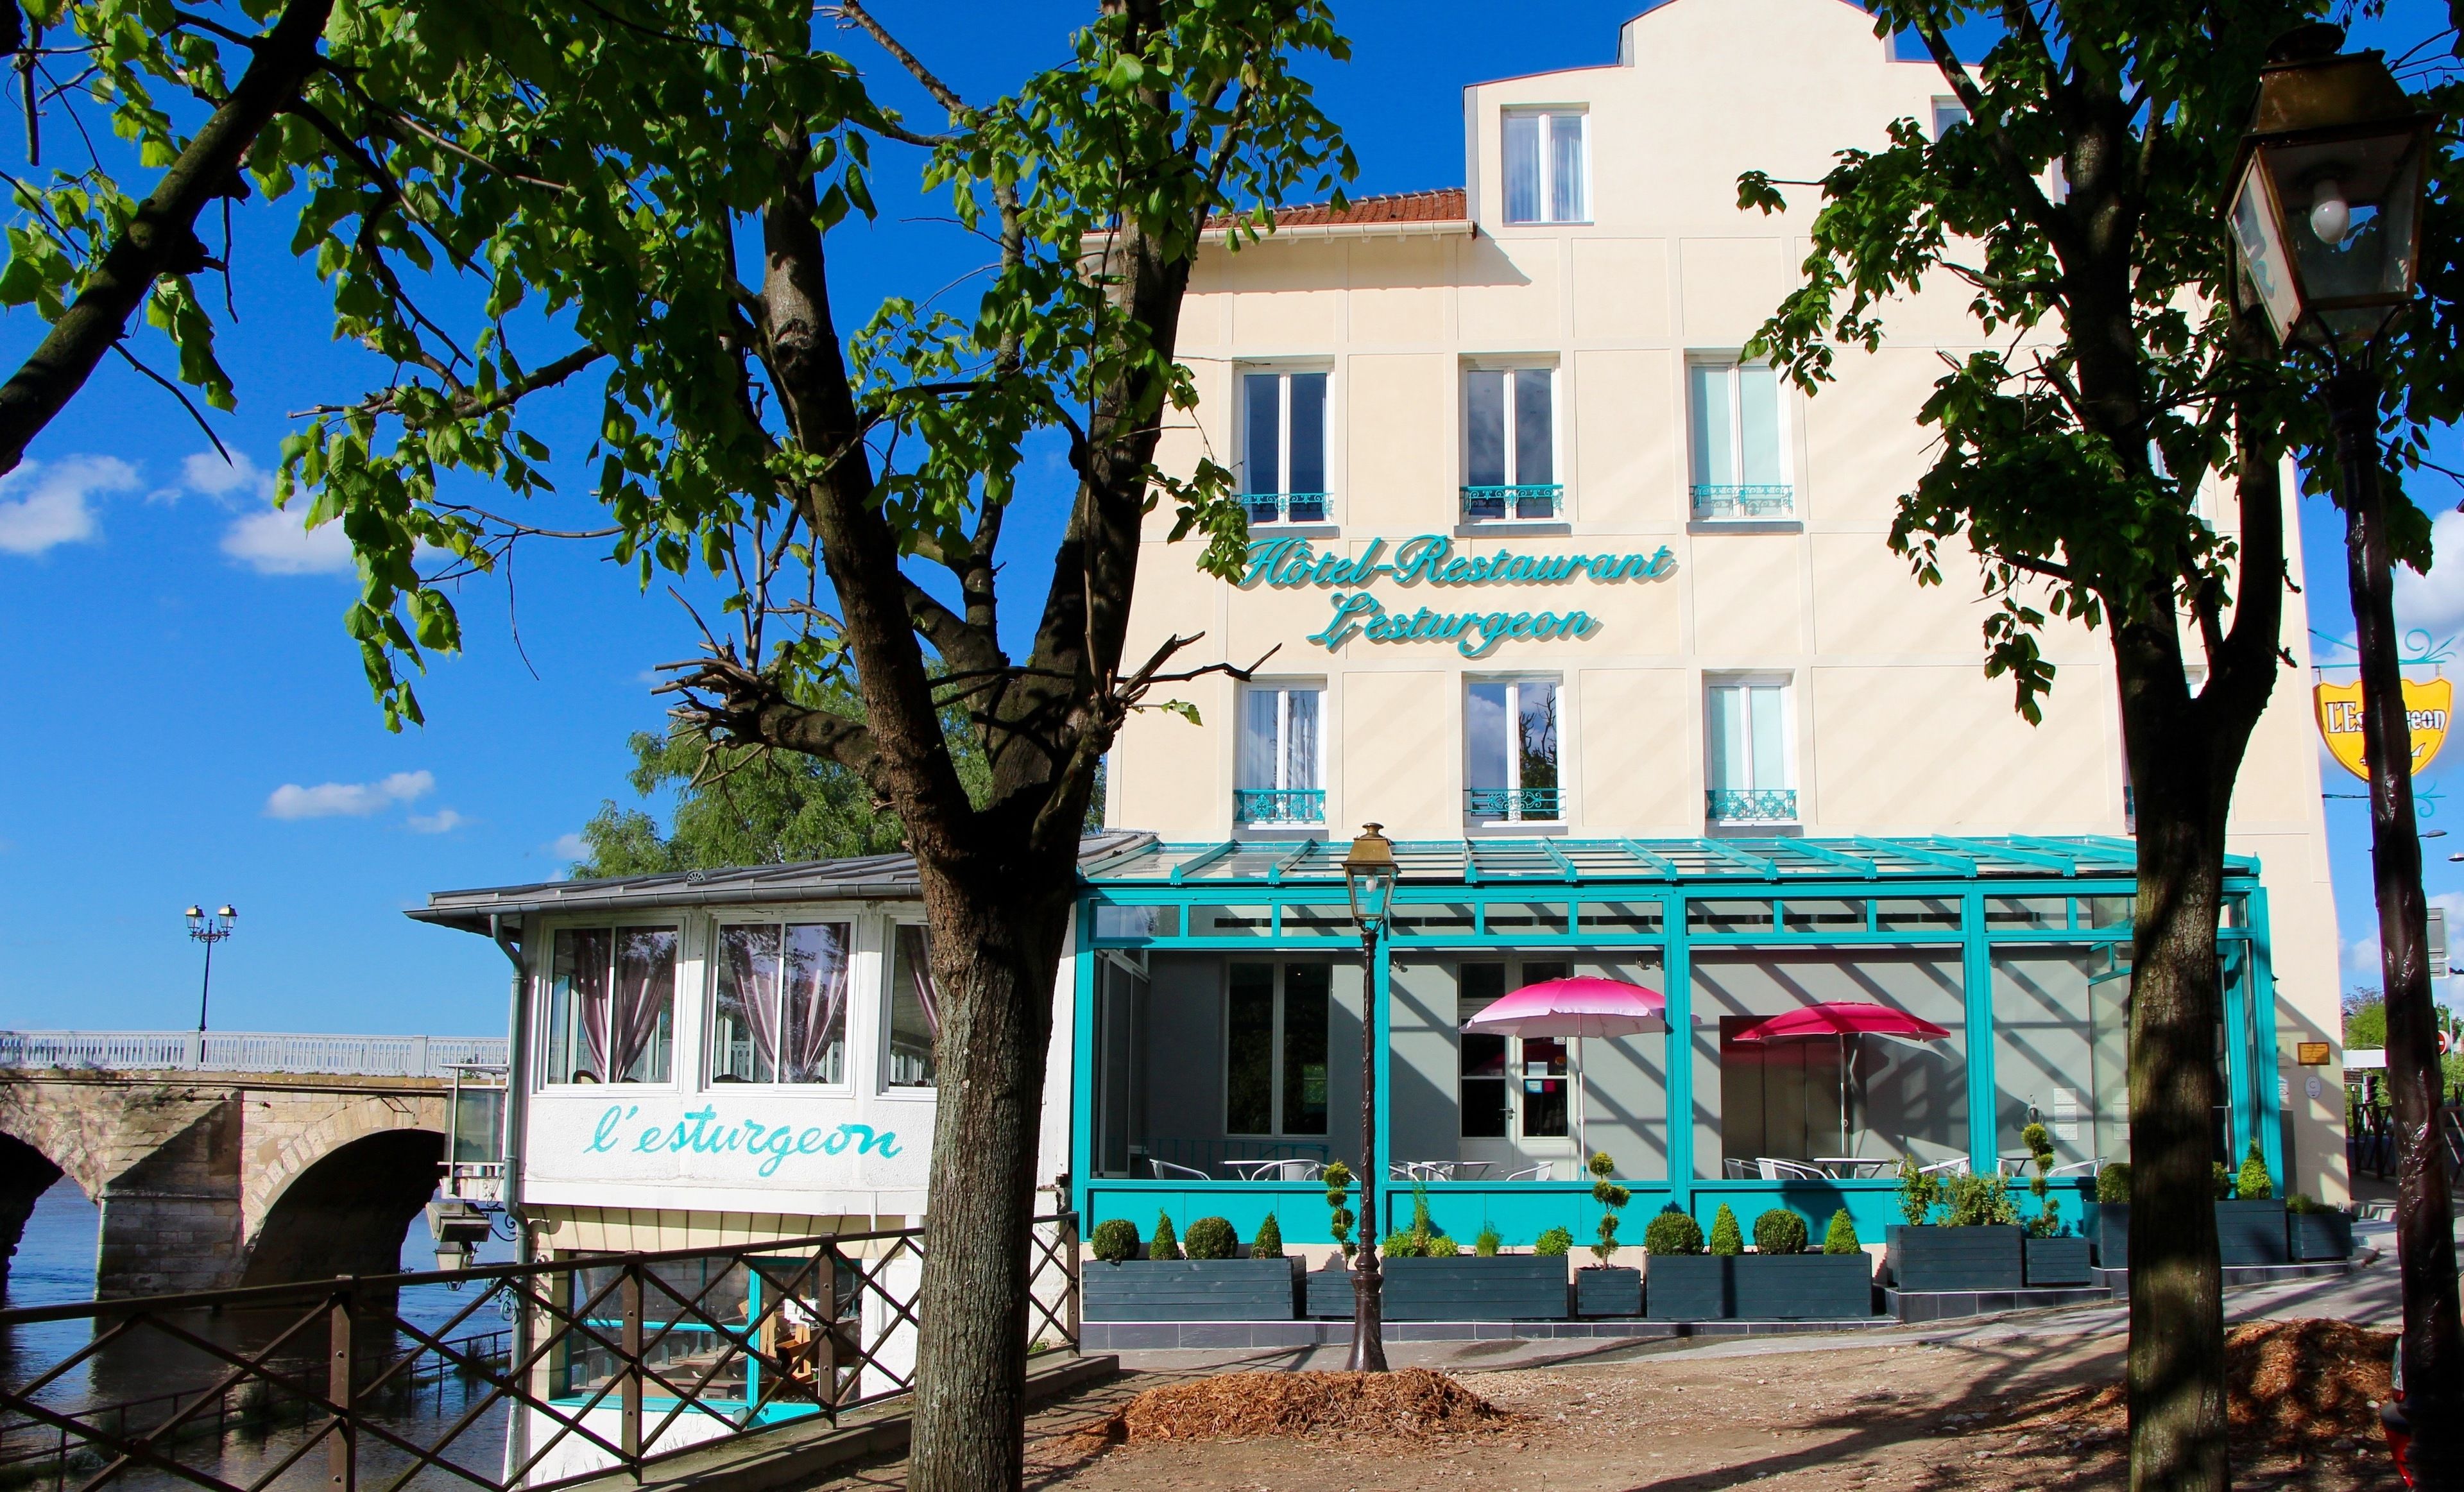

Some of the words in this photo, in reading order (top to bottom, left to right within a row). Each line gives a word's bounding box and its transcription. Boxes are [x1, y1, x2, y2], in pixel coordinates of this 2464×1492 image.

[1238, 535, 1674, 586] Hôtel-Restaurant
[1305, 591, 1596, 658] L'esturgeon
[2325, 701, 2446, 733] L'Eseon
[583, 1103, 903, 1178] l'esturgeon
